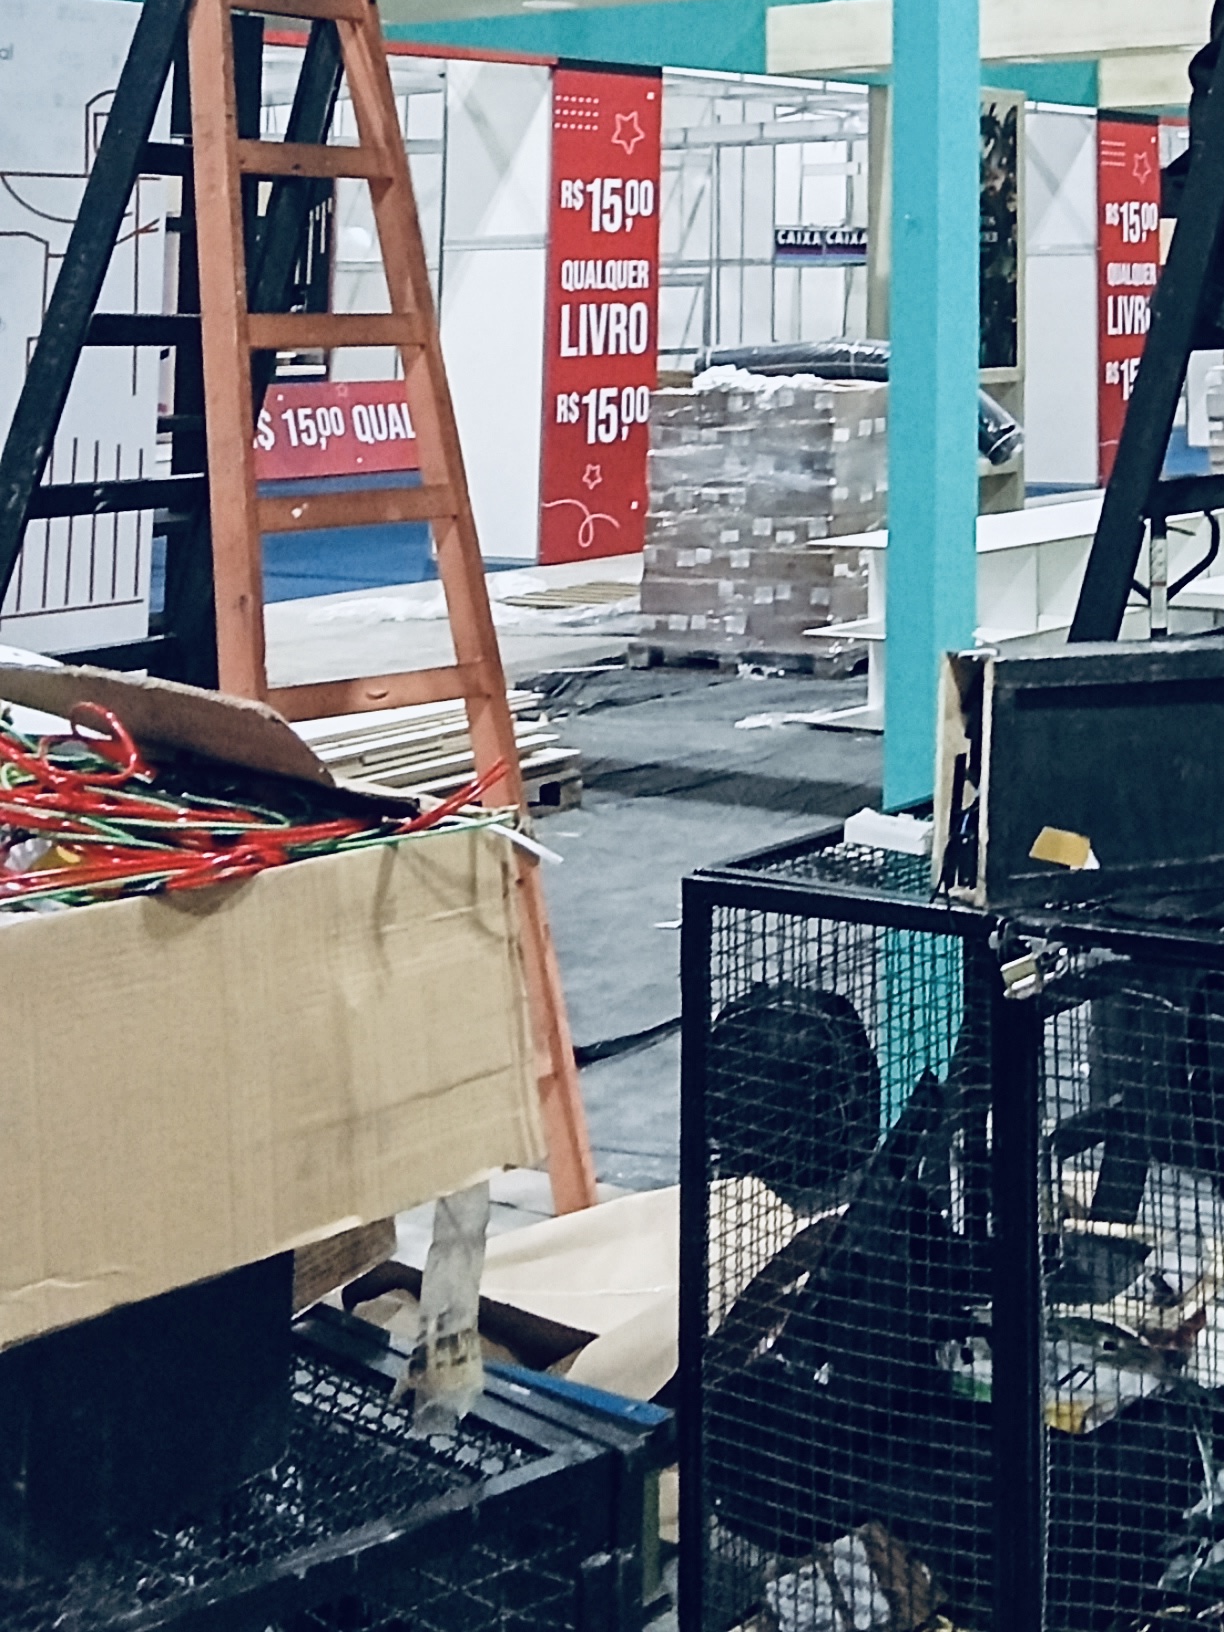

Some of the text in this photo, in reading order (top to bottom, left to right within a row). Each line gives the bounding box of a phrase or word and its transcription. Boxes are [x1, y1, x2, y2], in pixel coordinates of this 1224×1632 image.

[777, 230, 867, 245] CAIXA CAIXA
[561, 259, 649, 292] QUALQUER
[560, 301, 648, 357] LIVRO
[281, 406, 345, 450] 15,00
